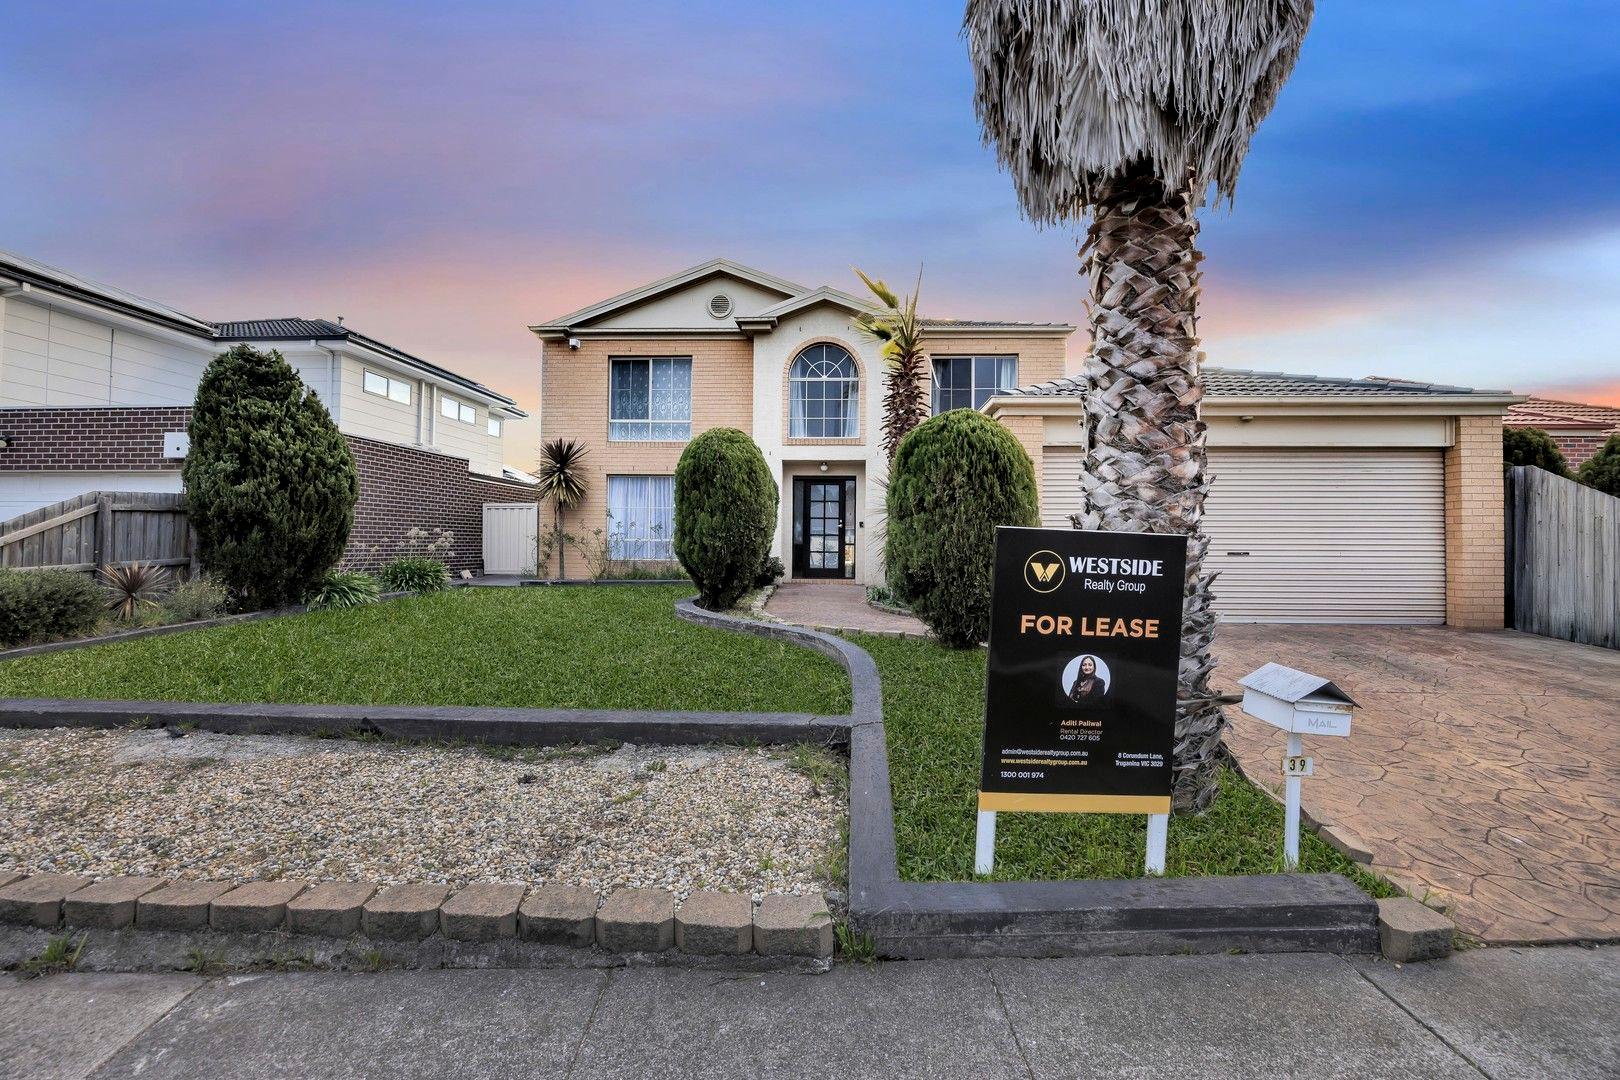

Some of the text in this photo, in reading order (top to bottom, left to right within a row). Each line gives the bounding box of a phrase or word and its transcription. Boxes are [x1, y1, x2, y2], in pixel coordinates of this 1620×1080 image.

[1069, 556, 1163, 577] WESTSIDE
[1084, 578, 1146, 594] Realty Group
[1021, 614, 1160, 638] FOR LEASE
[1289, 759, 1306, 771] 39
